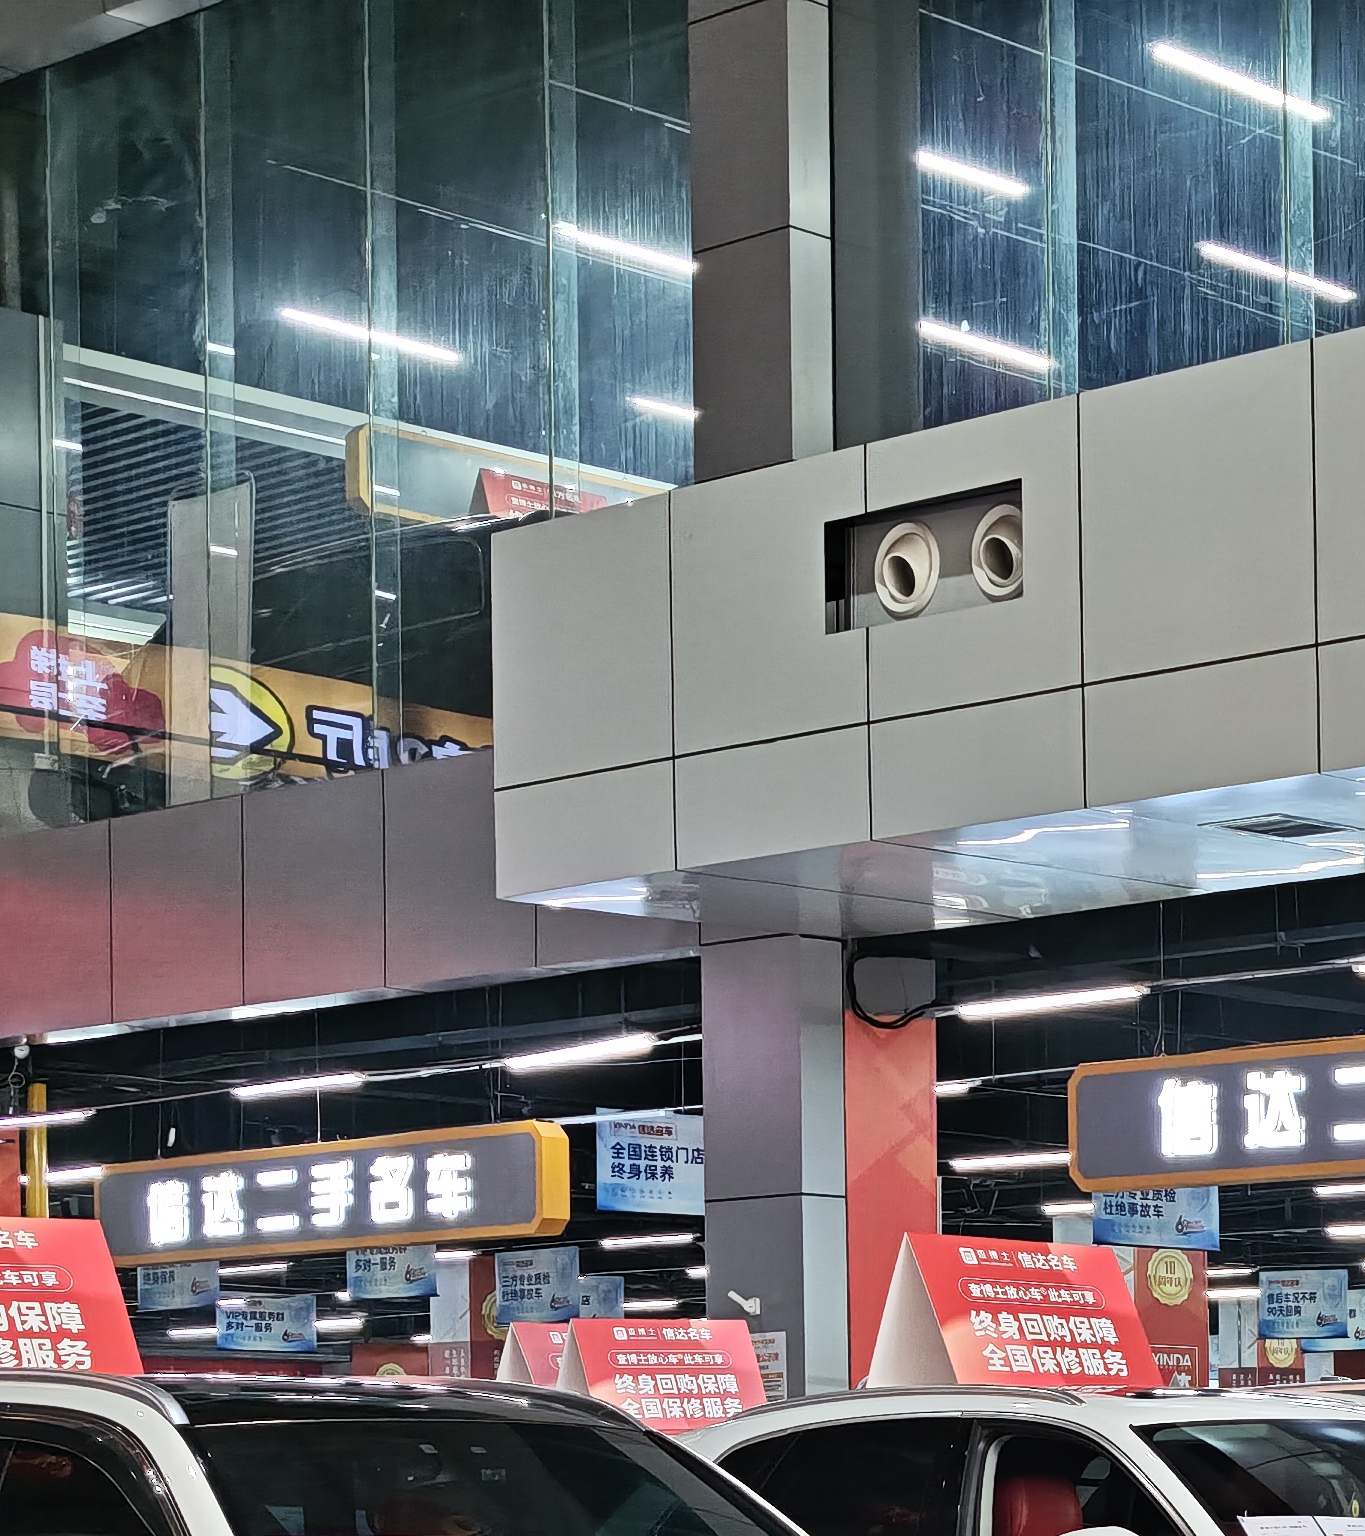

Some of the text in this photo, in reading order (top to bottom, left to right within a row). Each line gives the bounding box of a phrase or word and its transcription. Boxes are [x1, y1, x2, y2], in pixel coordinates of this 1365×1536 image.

[610, 1141, 705, 1165] 全国连锁门店
[610, 1162, 675, 1182] 终身保养
[146, 1153, 473, 1248] 信达二手名车
[1103, 1201, 1164, 1220] 杜绝事故车
[1018, 1251, 1079, 1272] 信达名车
[0, 1269, 60, 1287] 车可享
[0, 1302, 86, 1334] 保障
[969, 1309, 1120, 1346] 终身回购保障
[662, 1327, 713, 1341] 信达名车
[981, 1342, 1130, 1378] 全国保修服务
[614, 1373, 739, 1395] 终身回购保障
[620, 1396, 744, 1420] 全国保修服务
